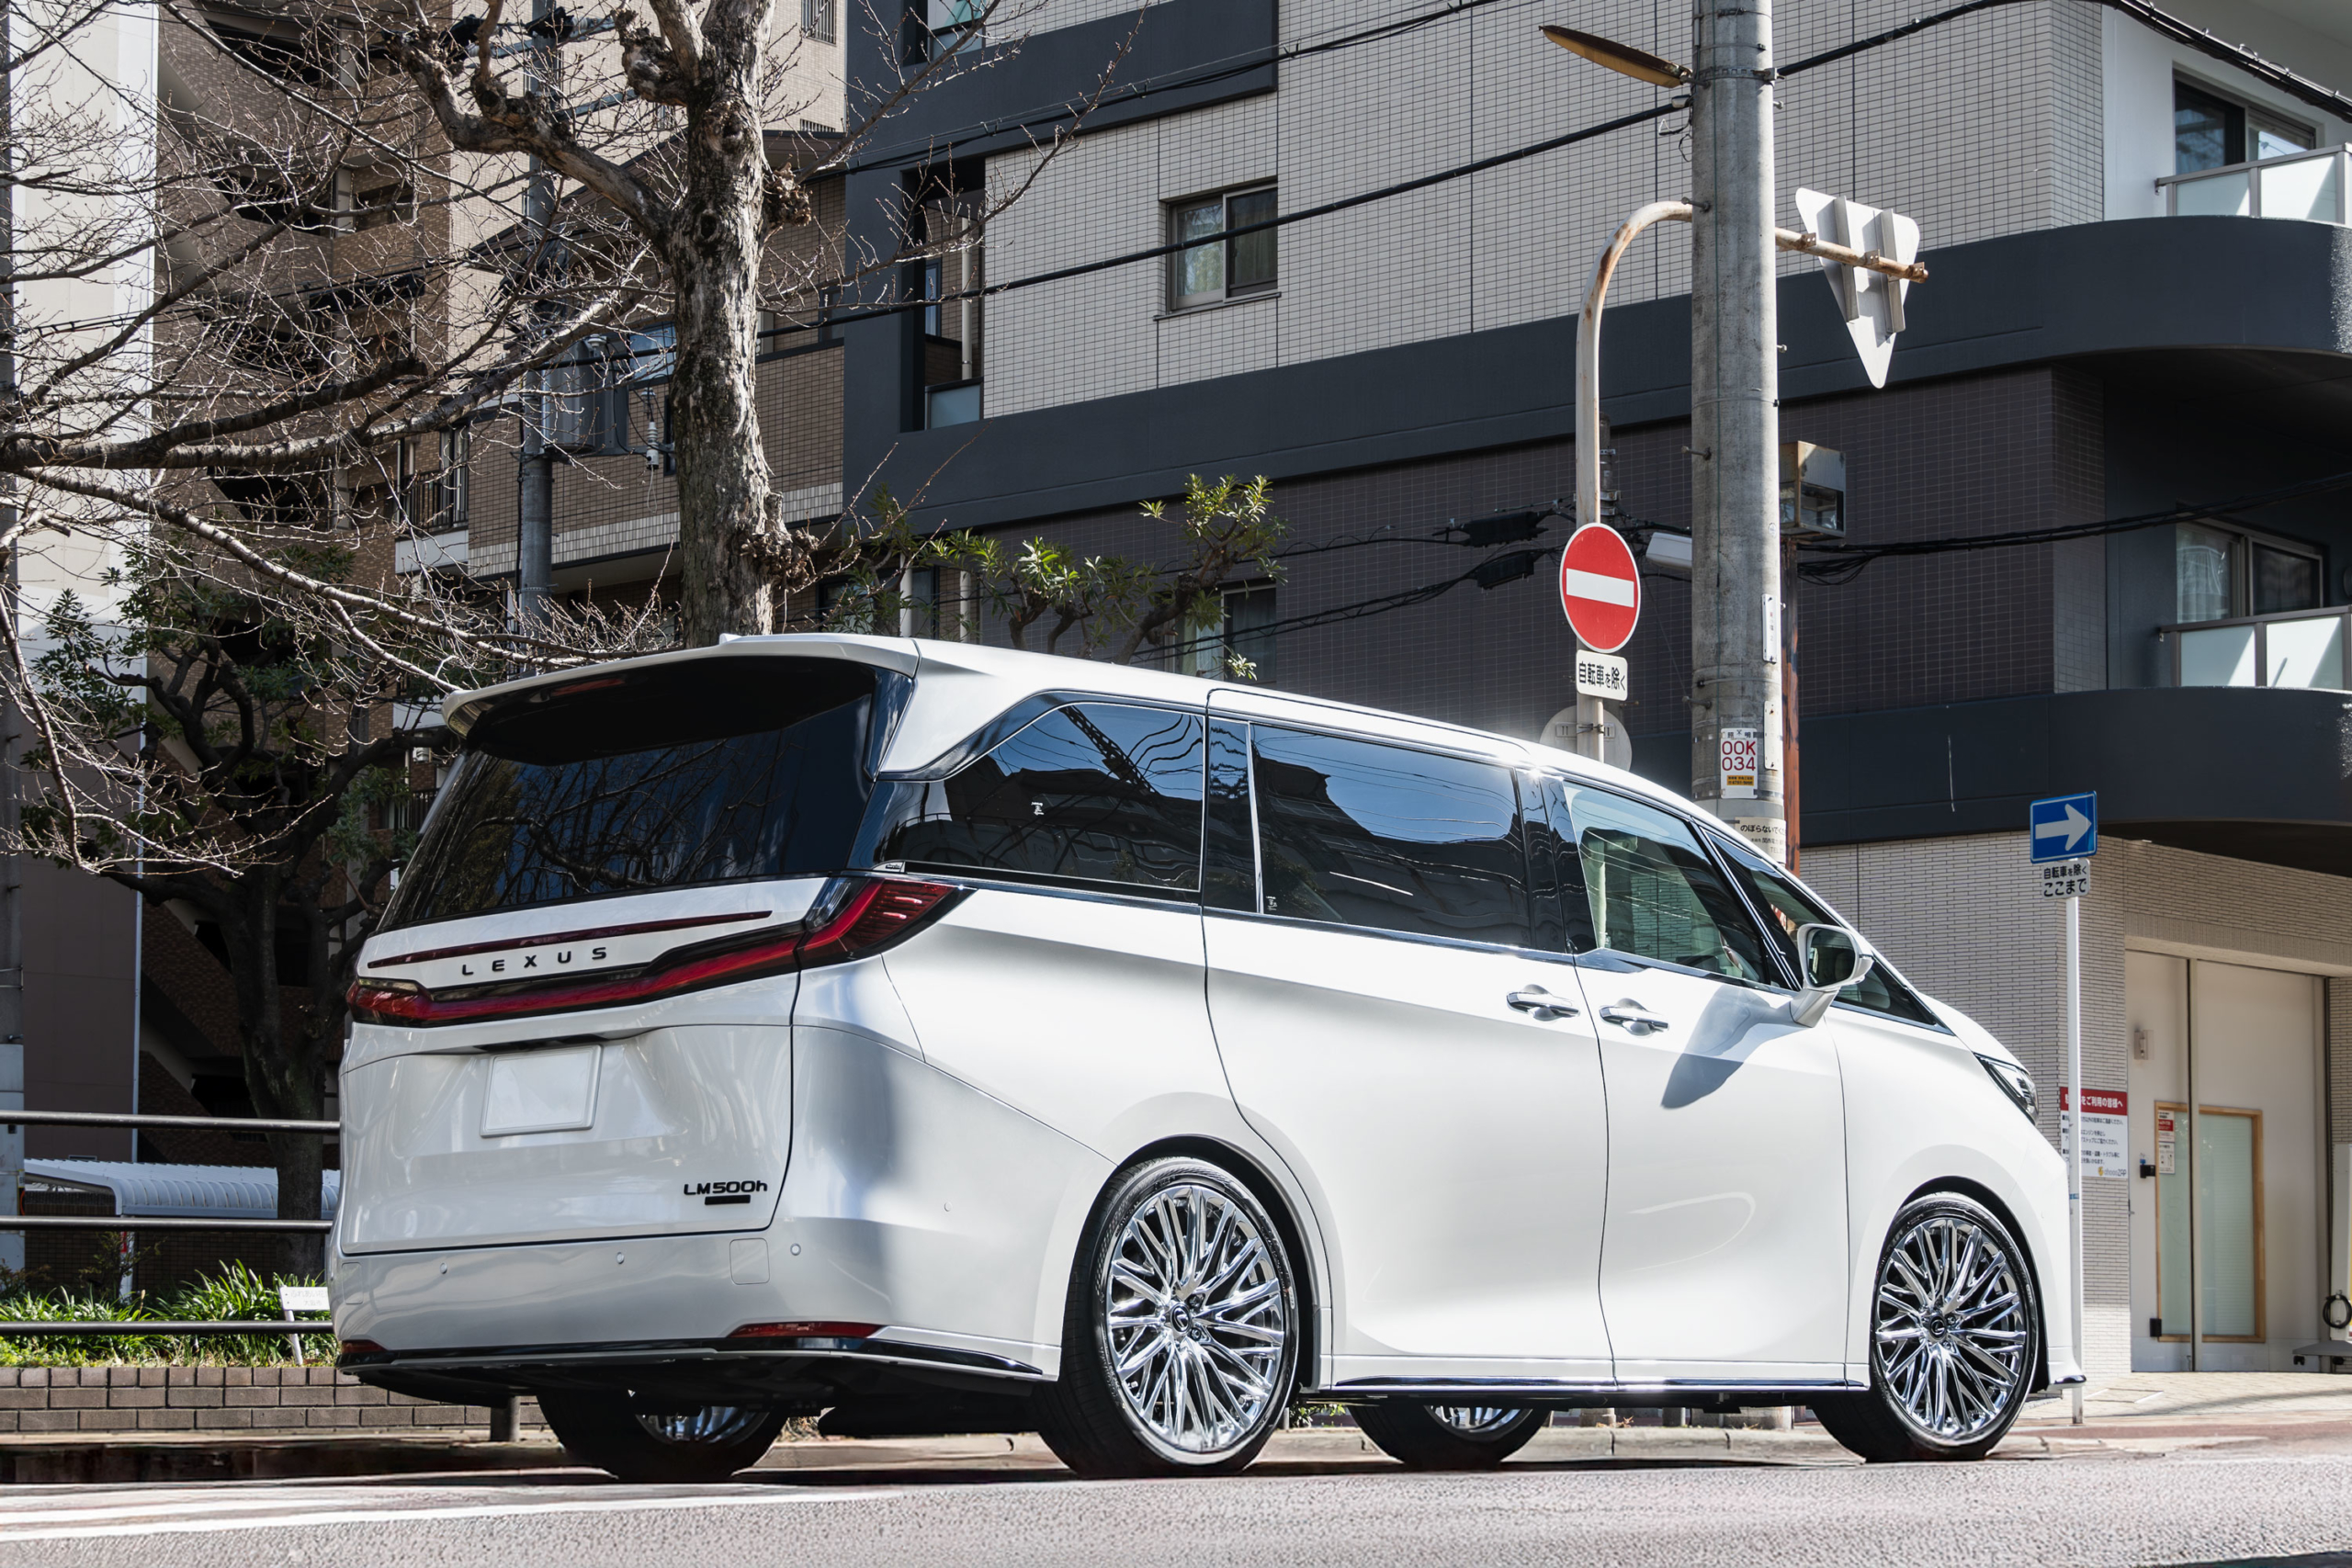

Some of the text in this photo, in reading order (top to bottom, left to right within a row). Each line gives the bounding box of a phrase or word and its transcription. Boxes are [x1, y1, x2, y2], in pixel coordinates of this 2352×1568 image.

[1578, 660, 1625, 691] 自転車を除く
[2043, 863, 2086, 879] 自転車を除く
[2043, 878, 2086, 897] ここまで
[462, 947, 606, 976] LEXUS
[684, 1180, 768, 1196] LM500h
